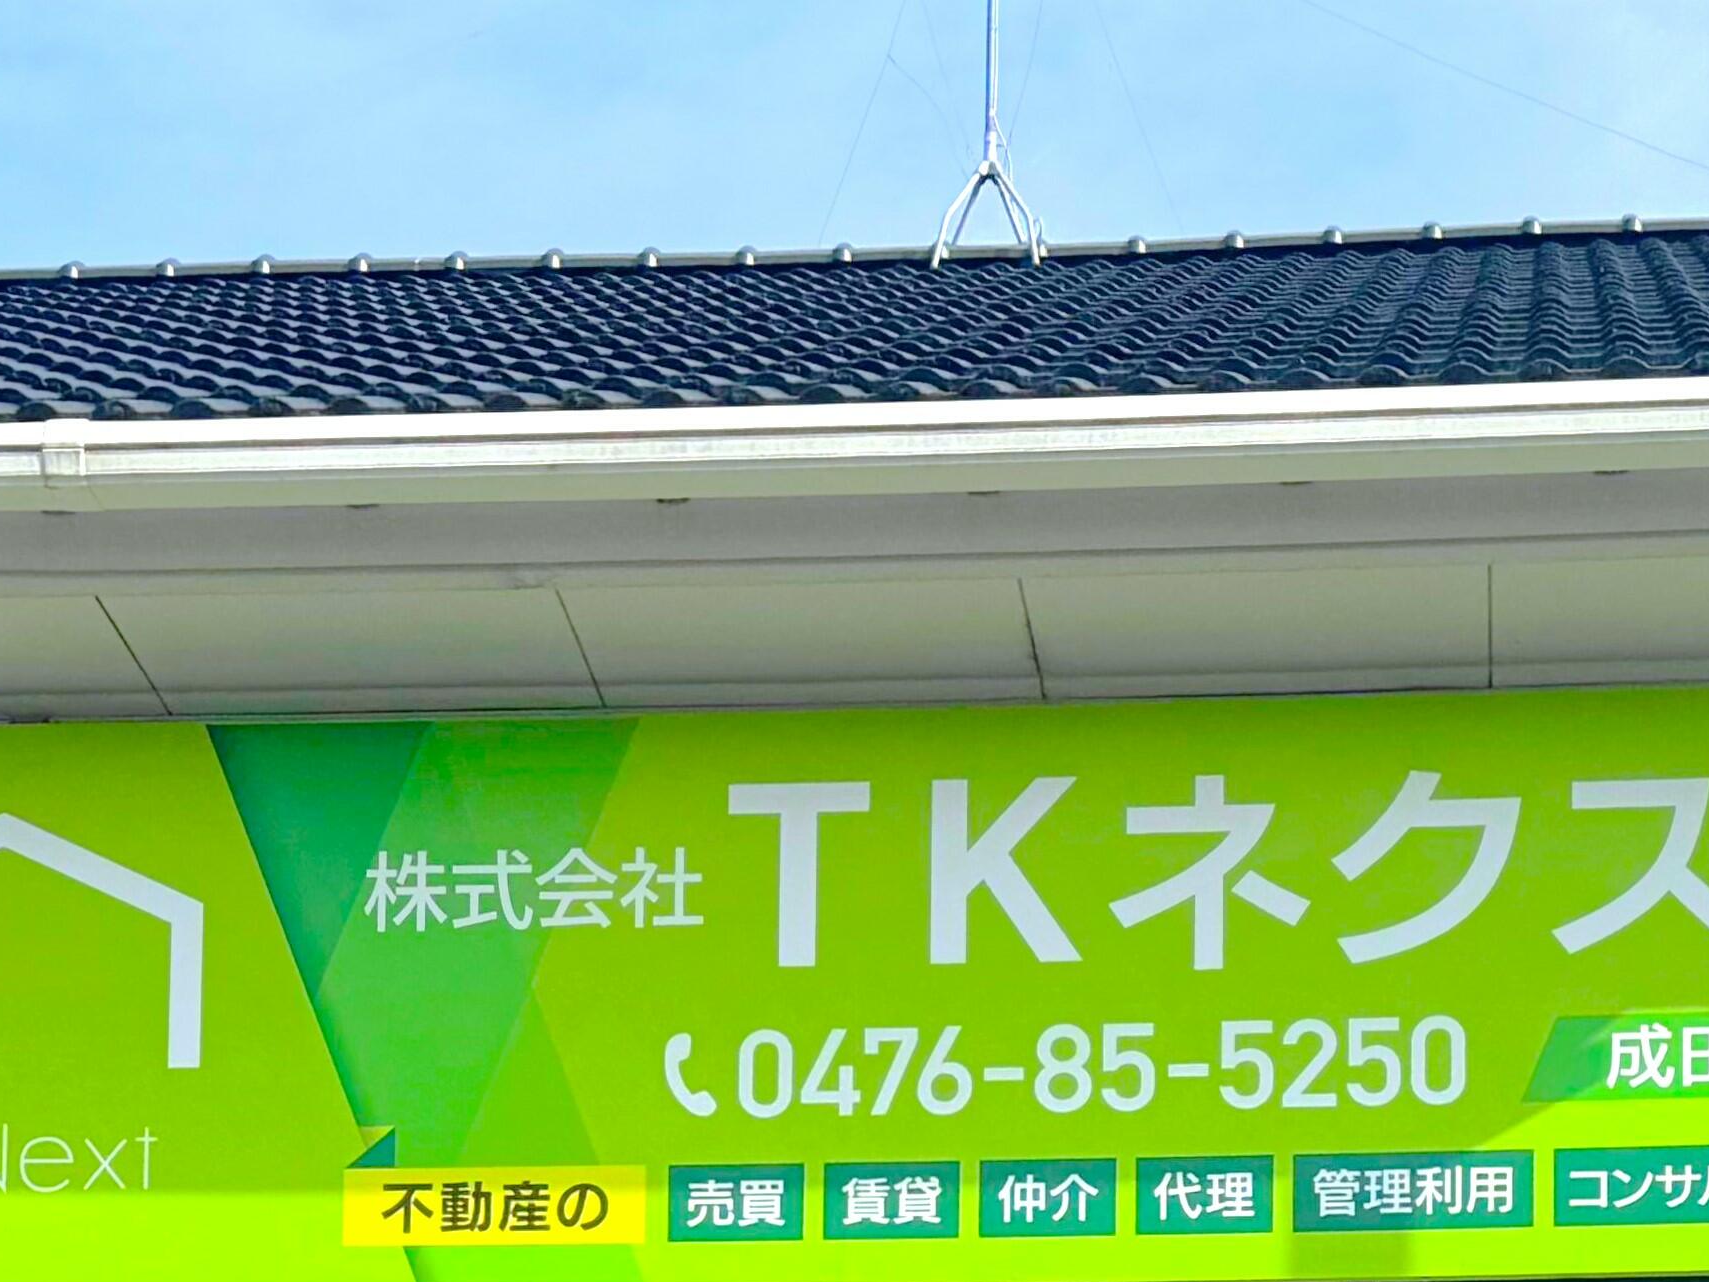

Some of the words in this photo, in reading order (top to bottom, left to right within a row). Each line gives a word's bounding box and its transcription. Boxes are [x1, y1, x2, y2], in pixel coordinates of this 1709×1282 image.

[364, 847, 703, 934] 株式会社
[737, 1015, 1468, 1119] 0476-85-5250
[380, 1179, 610, 1235] 不動産の
[686, 1180, 783, 1231] 売買
[842, 1177, 944, 1228] 賃貸
[998, 1174, 1099, 1225] 仲介
[1154, 1171, 1255, 1221] 代理
[1311, 1165, 1516, 1217] 管理利用
